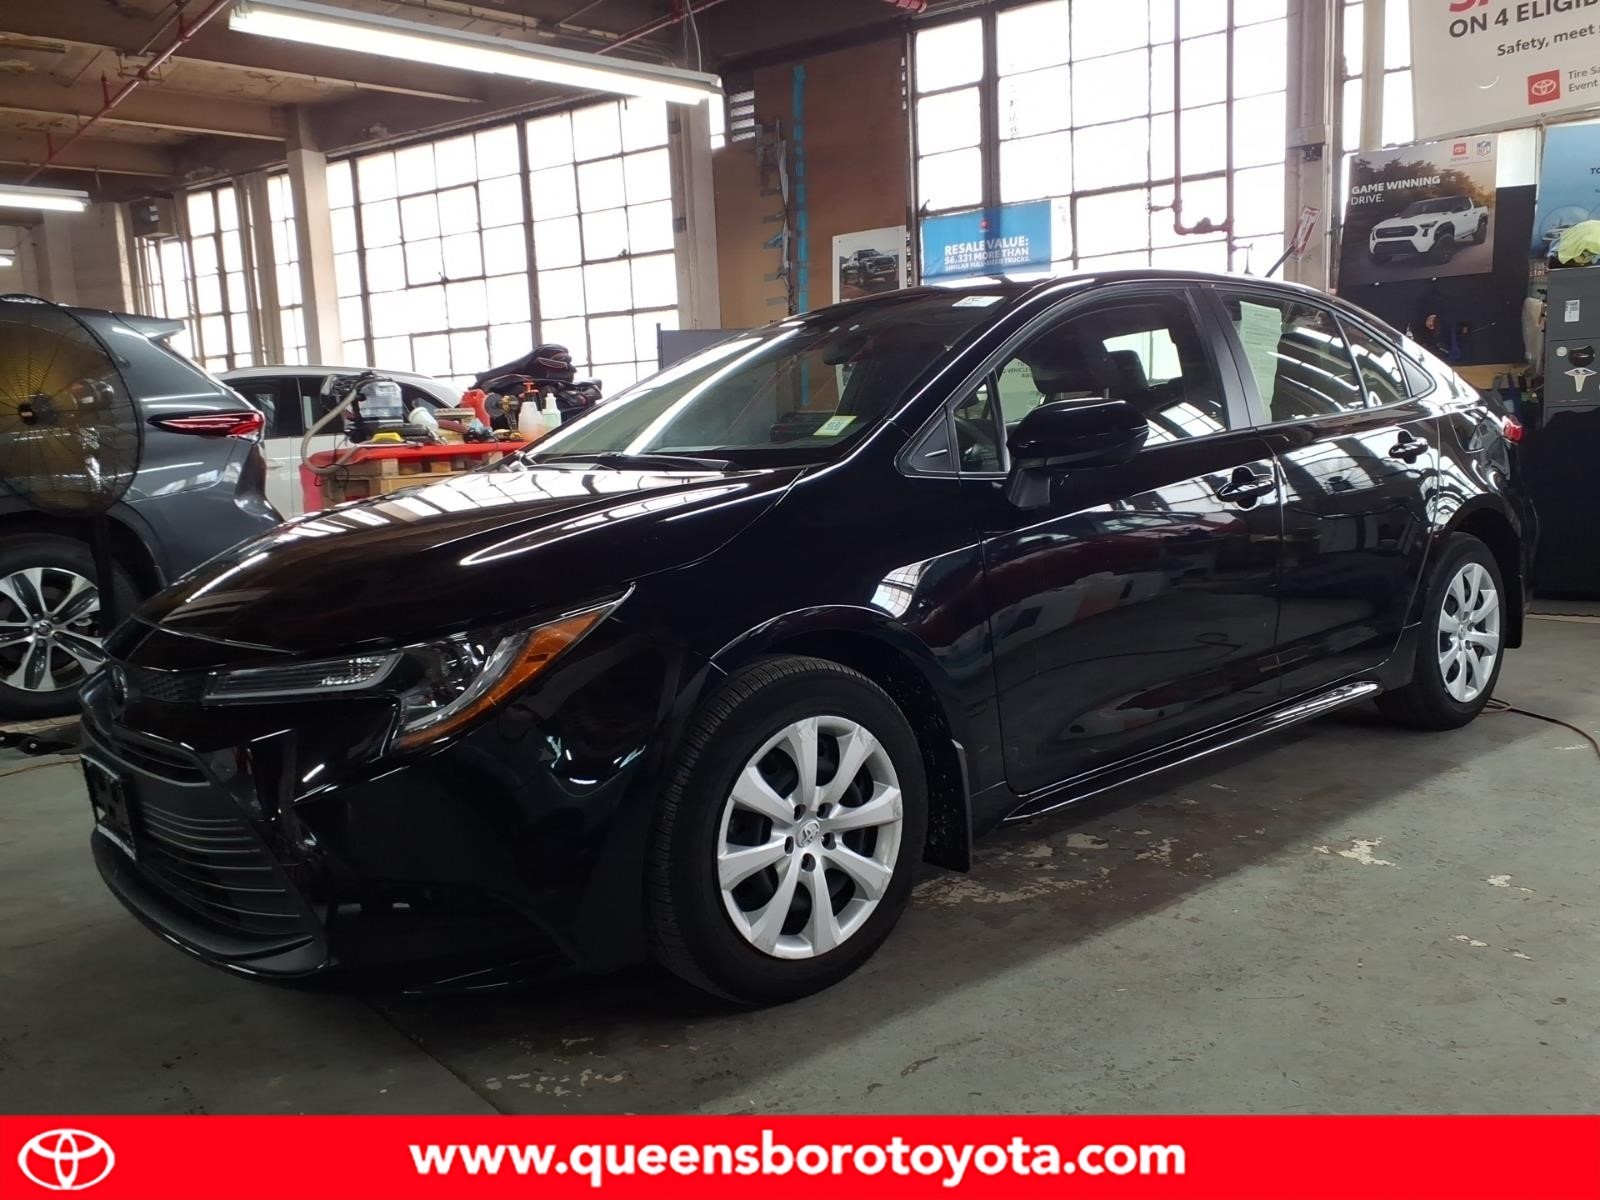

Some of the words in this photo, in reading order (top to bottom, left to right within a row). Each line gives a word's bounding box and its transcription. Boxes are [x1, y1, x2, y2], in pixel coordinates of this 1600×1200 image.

[1449, 13, 1488, 38] ON
[1494, 8, 1509, 26] 4
[1497, 37, 1549, 56] Safety,
[1554, 24, 1596, 43] meet
[1568, 70, 1588, 80] Tire
[1568, 79, 1599, 93] Event
[1352, 182, 1385, 195] GAME
[1386, 175, 1441, 190] WINNING
[1351, 193, 1385, 206] DRIVE.
[944, 240, 985, 256] RESALE
[986, 235, 1029, 251] VALUE:
[973, 249, 1001, 261] MORE
[1001, 247, 1029, 258] THAN
